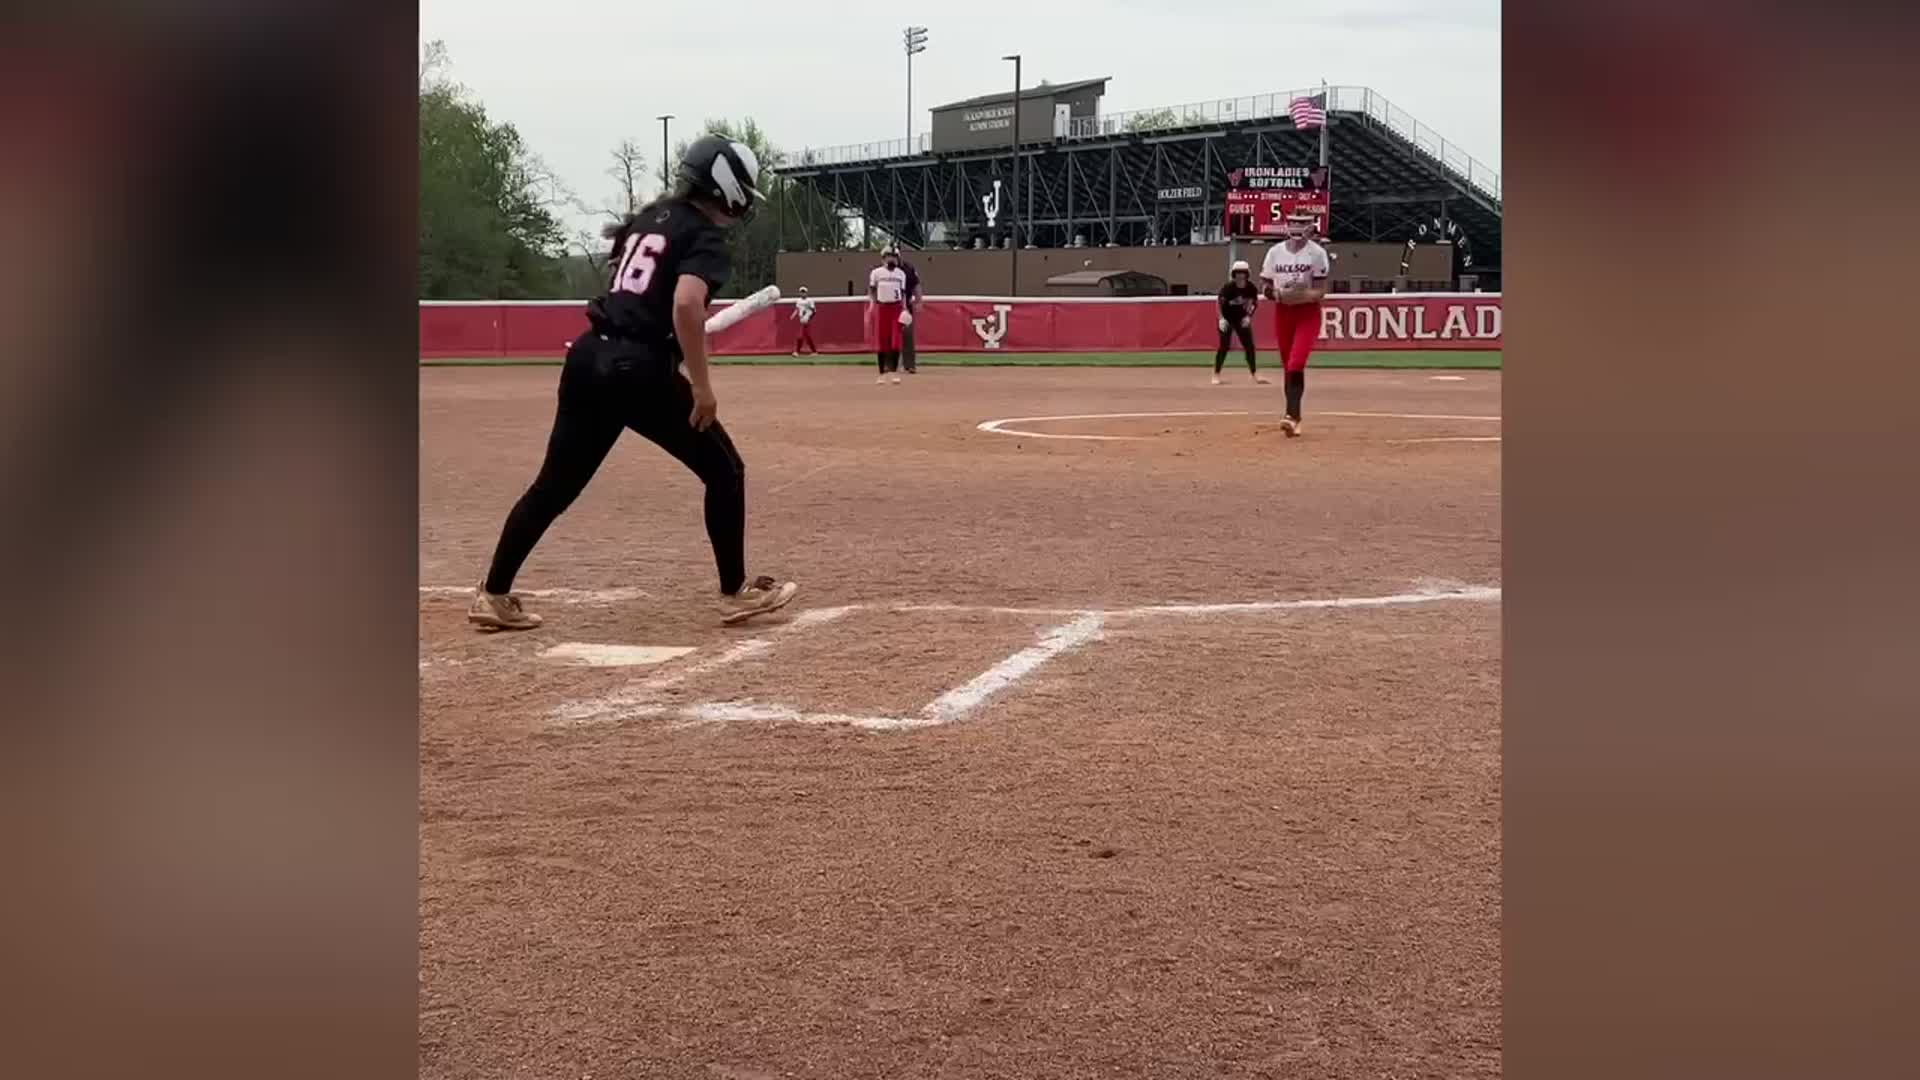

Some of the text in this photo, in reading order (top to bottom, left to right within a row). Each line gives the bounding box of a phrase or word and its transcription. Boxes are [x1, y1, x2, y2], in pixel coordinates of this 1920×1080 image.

[1244, 167, 1311, 177] IRONLADIES
[1249, 178, 1304, 188] SOFTBALL
[1229, 204, 1255, 214] GUEST
[1270, 202, 1281, 221] 5
[609, 231, 667, 295] 16
[1275, 263, 1312, 274] JACKSON
